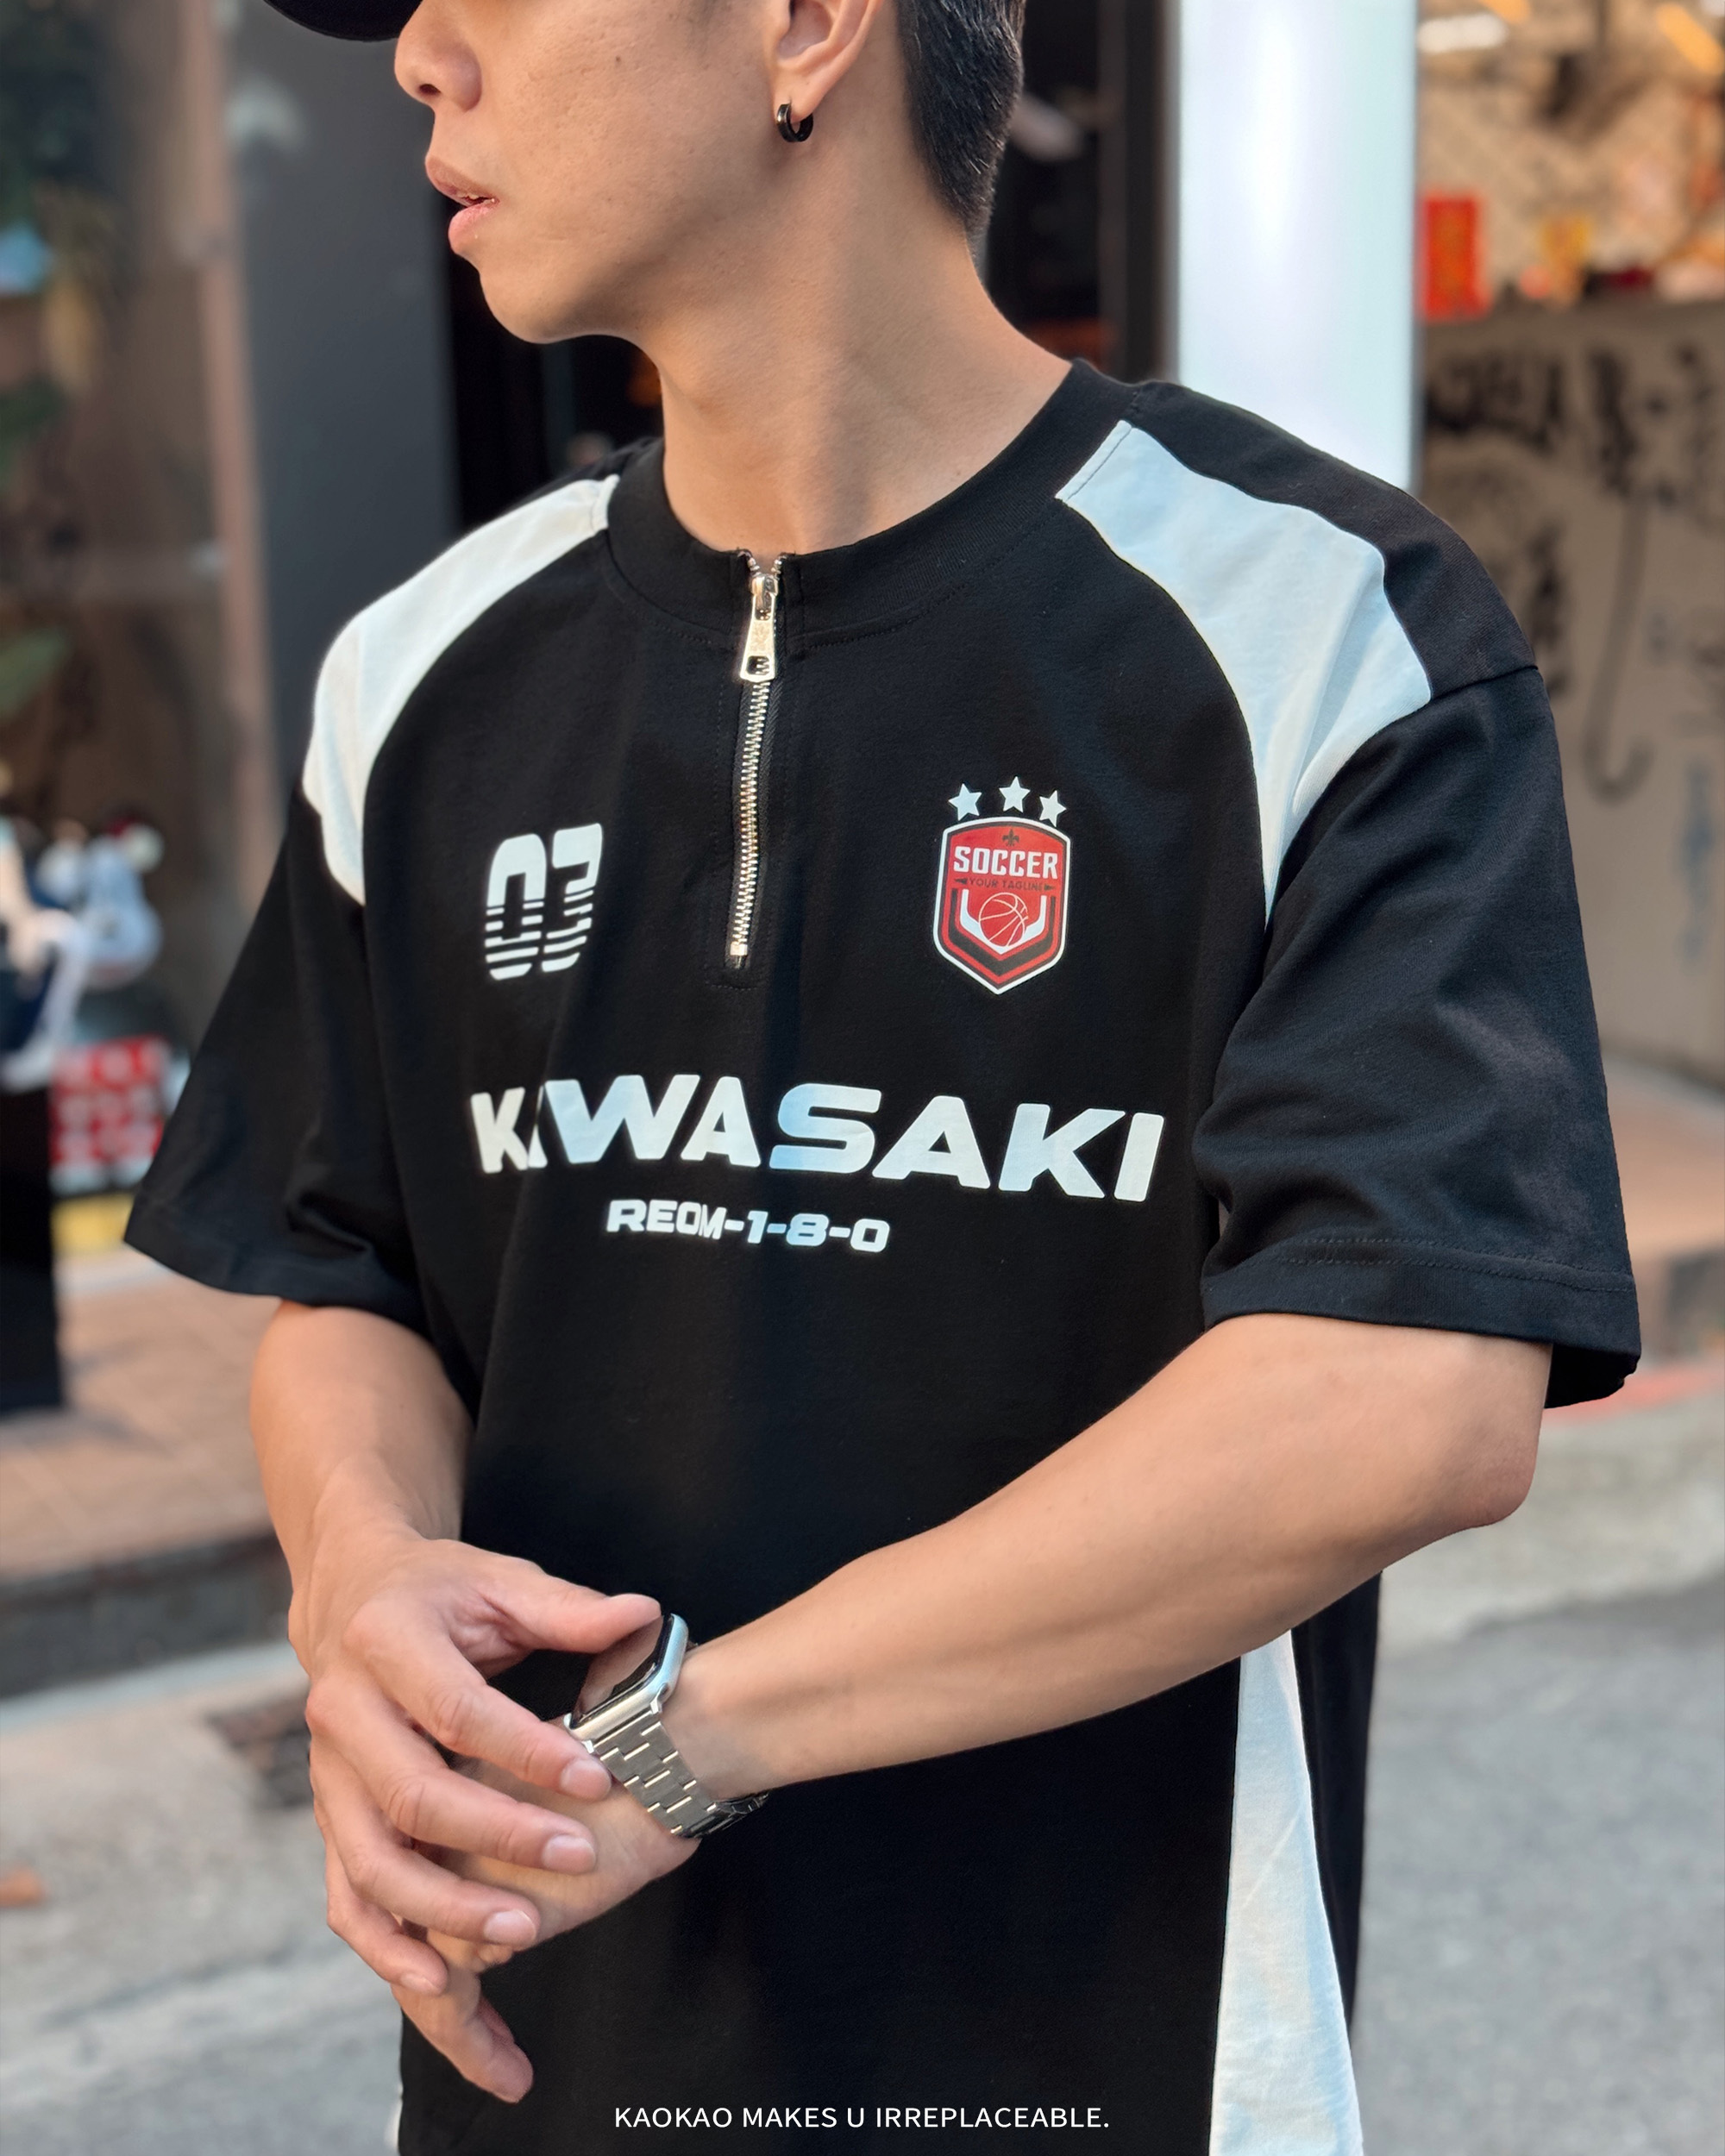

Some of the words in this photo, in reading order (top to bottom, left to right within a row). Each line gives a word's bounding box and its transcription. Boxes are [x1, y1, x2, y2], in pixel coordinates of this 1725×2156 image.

[953, 846, 1058, 879] SOCCER
[969, 878, 999, 888] YOUR
[1002, 881, 1043, 892] TAGLINE
